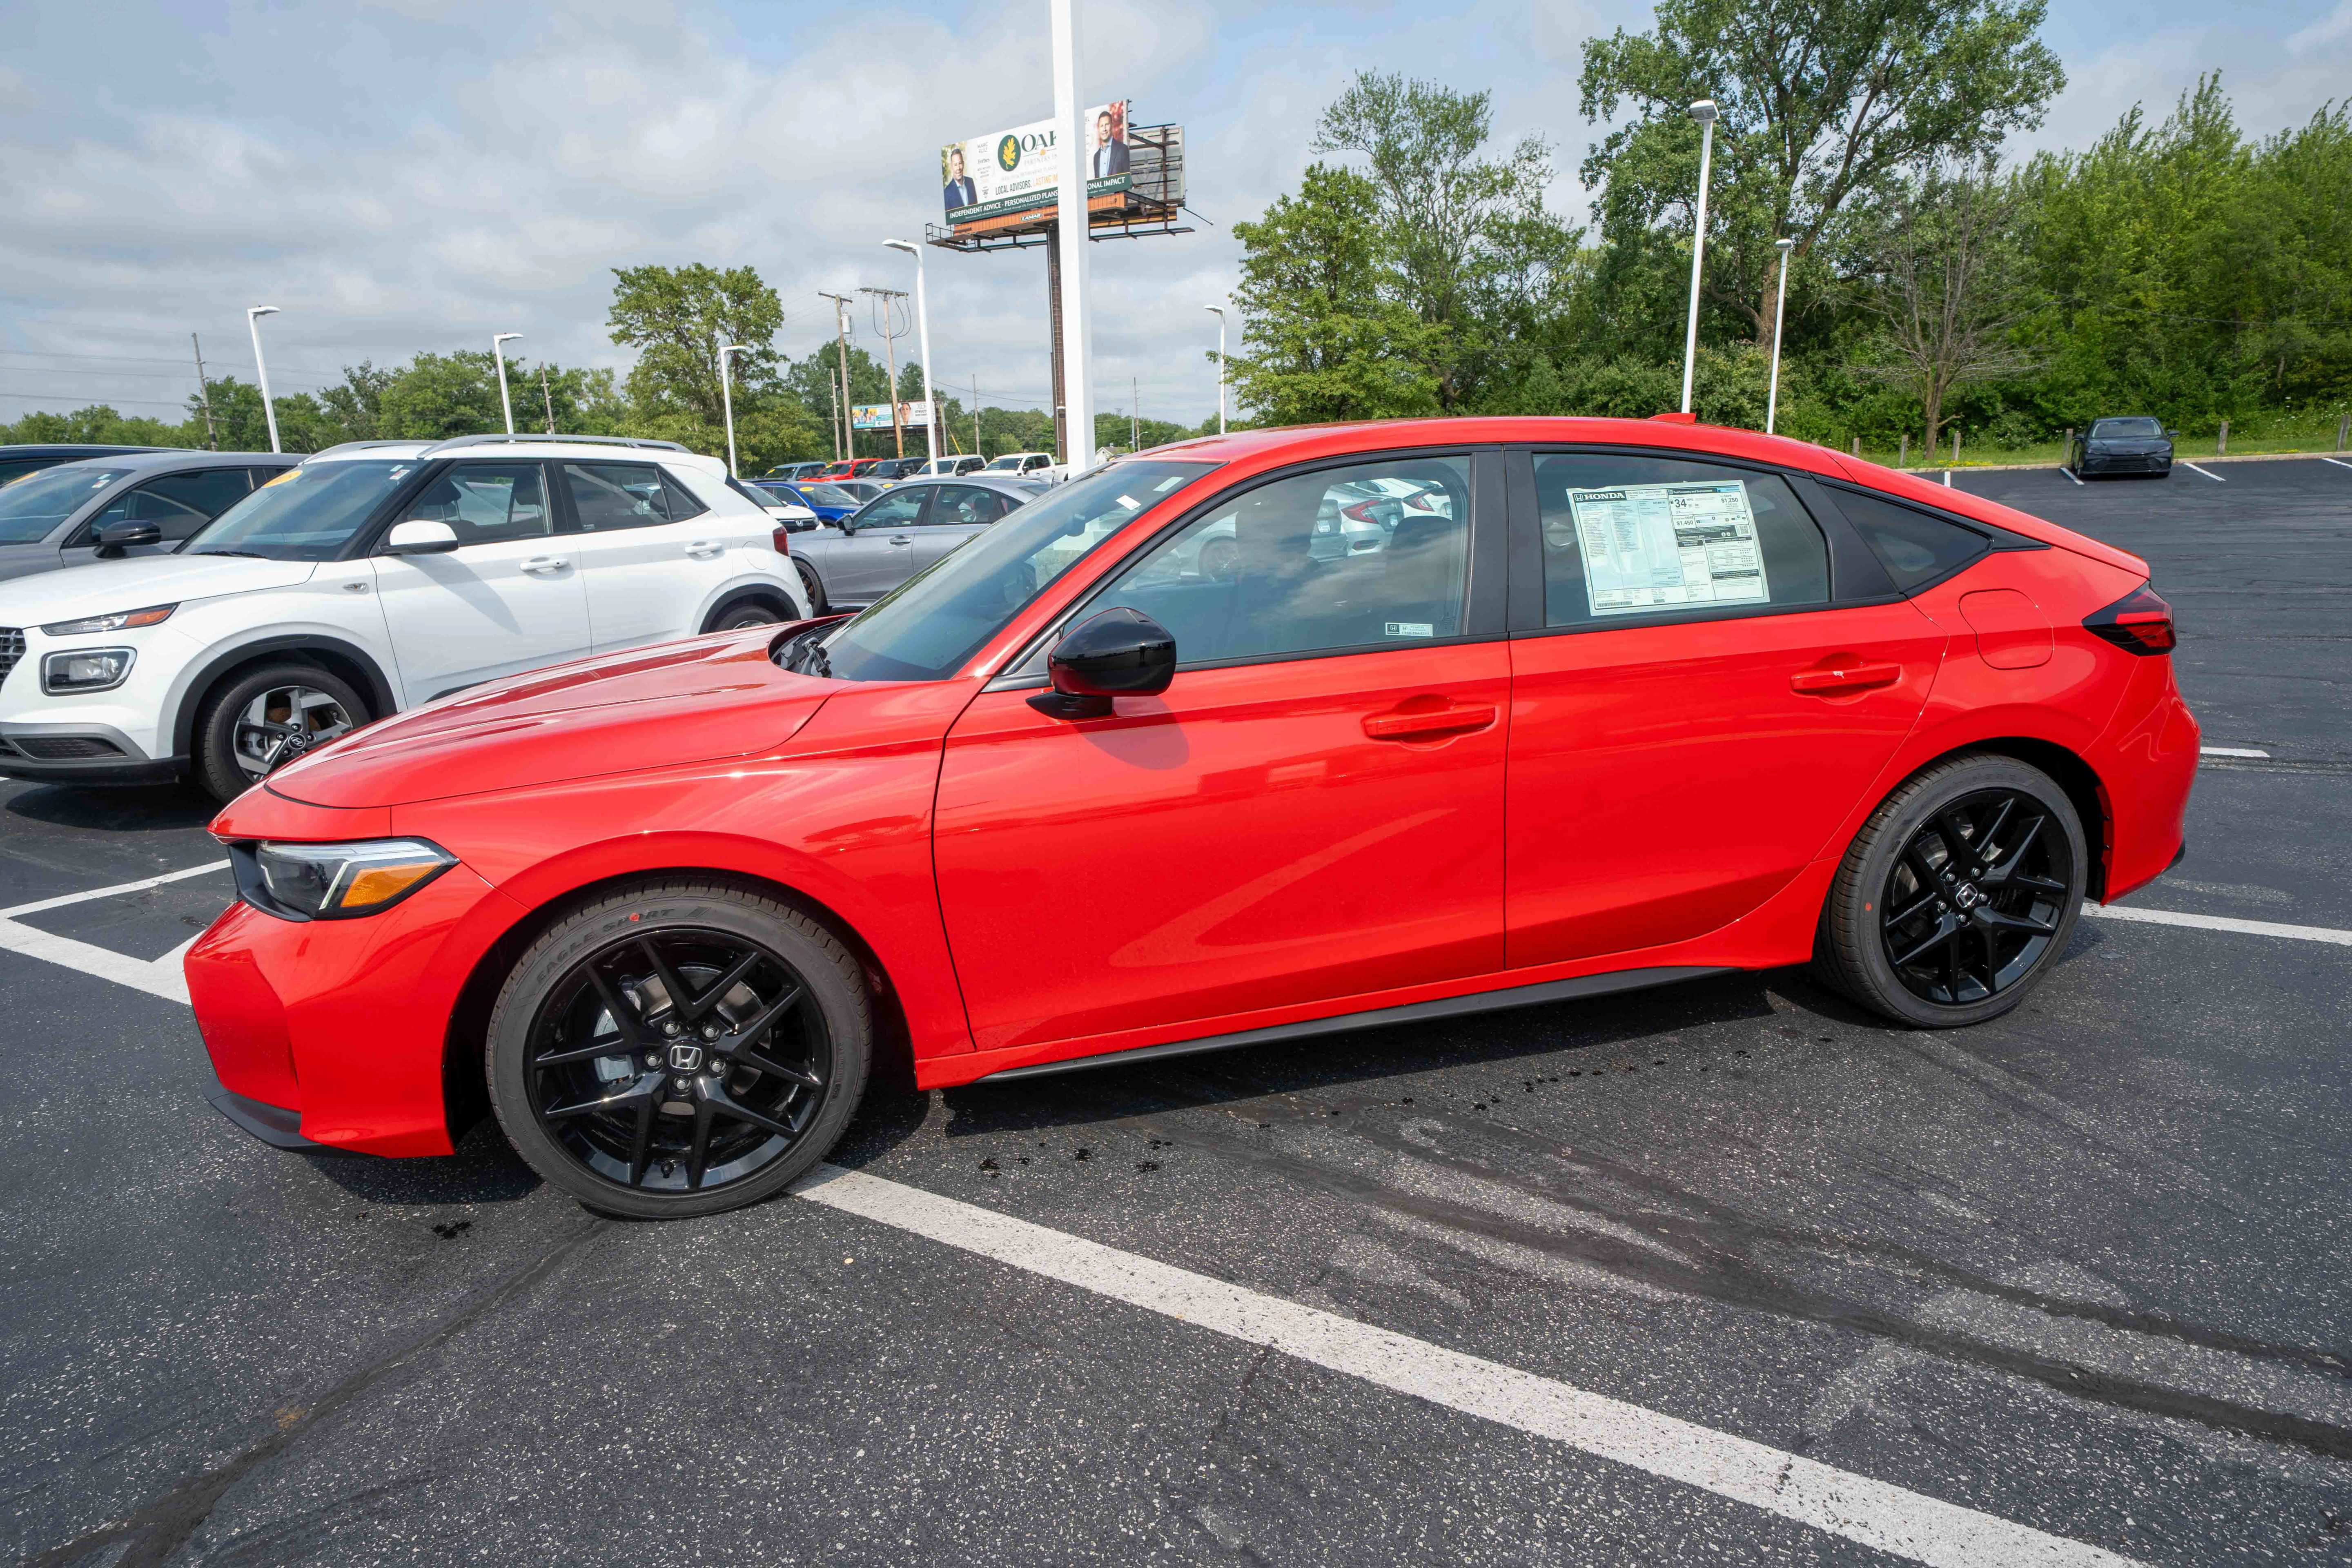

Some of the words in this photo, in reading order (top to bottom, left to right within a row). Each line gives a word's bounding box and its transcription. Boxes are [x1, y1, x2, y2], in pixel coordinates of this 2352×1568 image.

[1104, 176, 1125, 187] IMPACT
[996, 187, 1009, 195] LOCAL
[950, 206, 983, 219] INDEPENDENT
[983, 202, 1001, 212] ADVICE
[1004, 193, 1041, 207] PERSONALIZED
[1042, 190, 1058, 199] PLANS
[1674, 499, 1687, 508] 34
[537, 931, 596, 984] EAGLE
